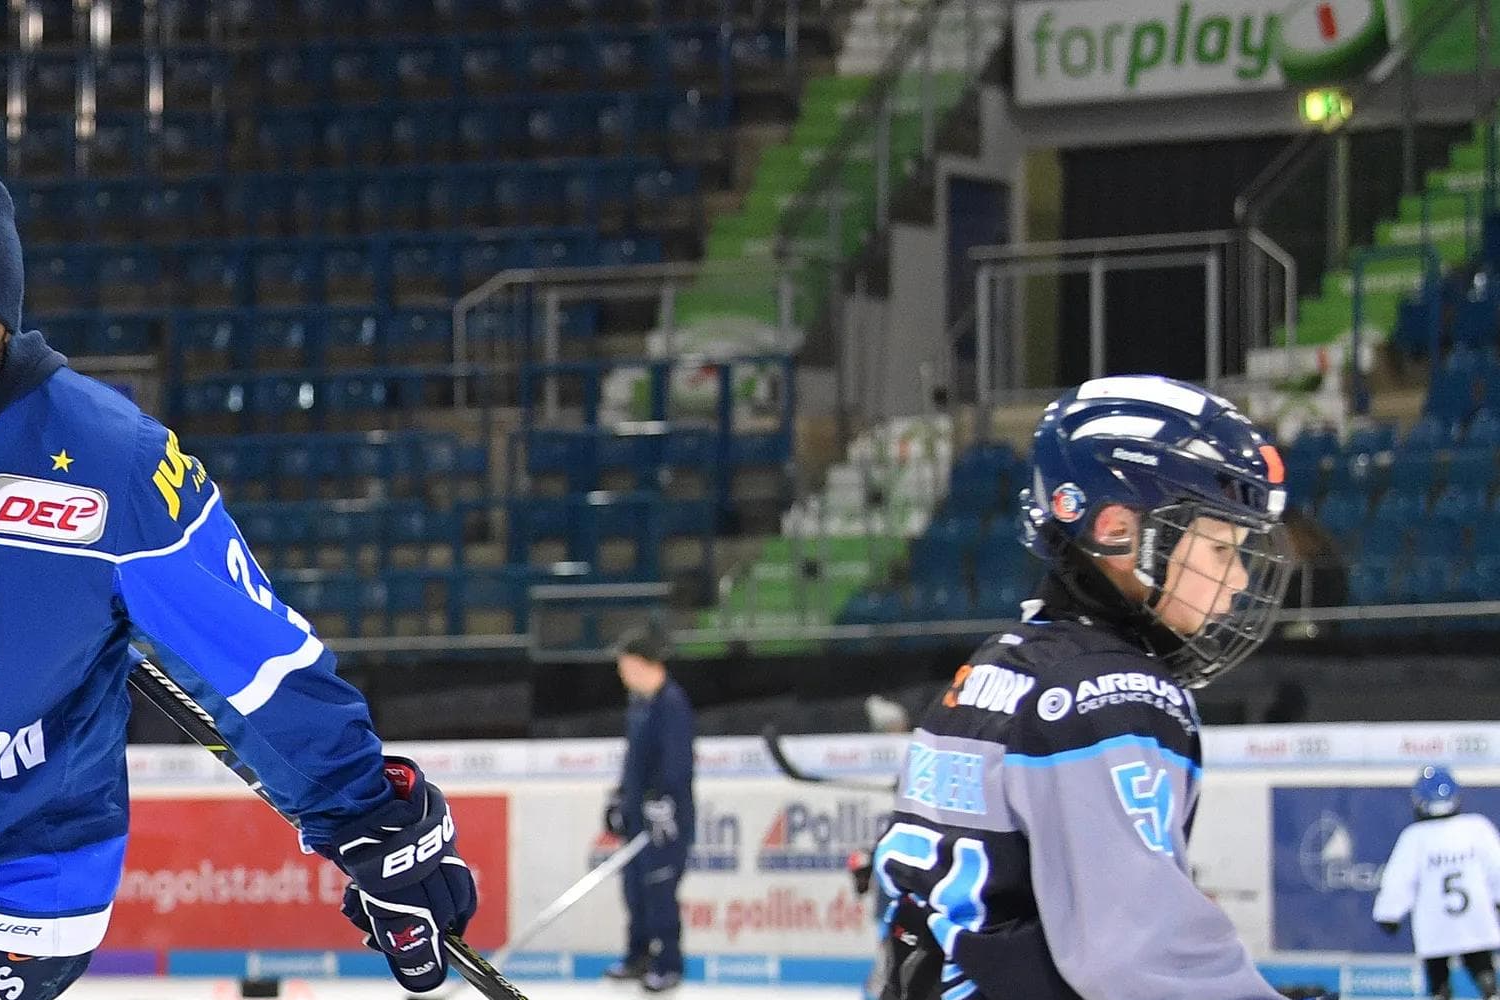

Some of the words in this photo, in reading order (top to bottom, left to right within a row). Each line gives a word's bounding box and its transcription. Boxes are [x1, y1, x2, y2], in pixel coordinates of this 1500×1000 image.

[1032, 1, 1284, 88] forplay
[1076, 672, 1183, 706] AIRBUS
[1443, 871, 1470, 918] 5
